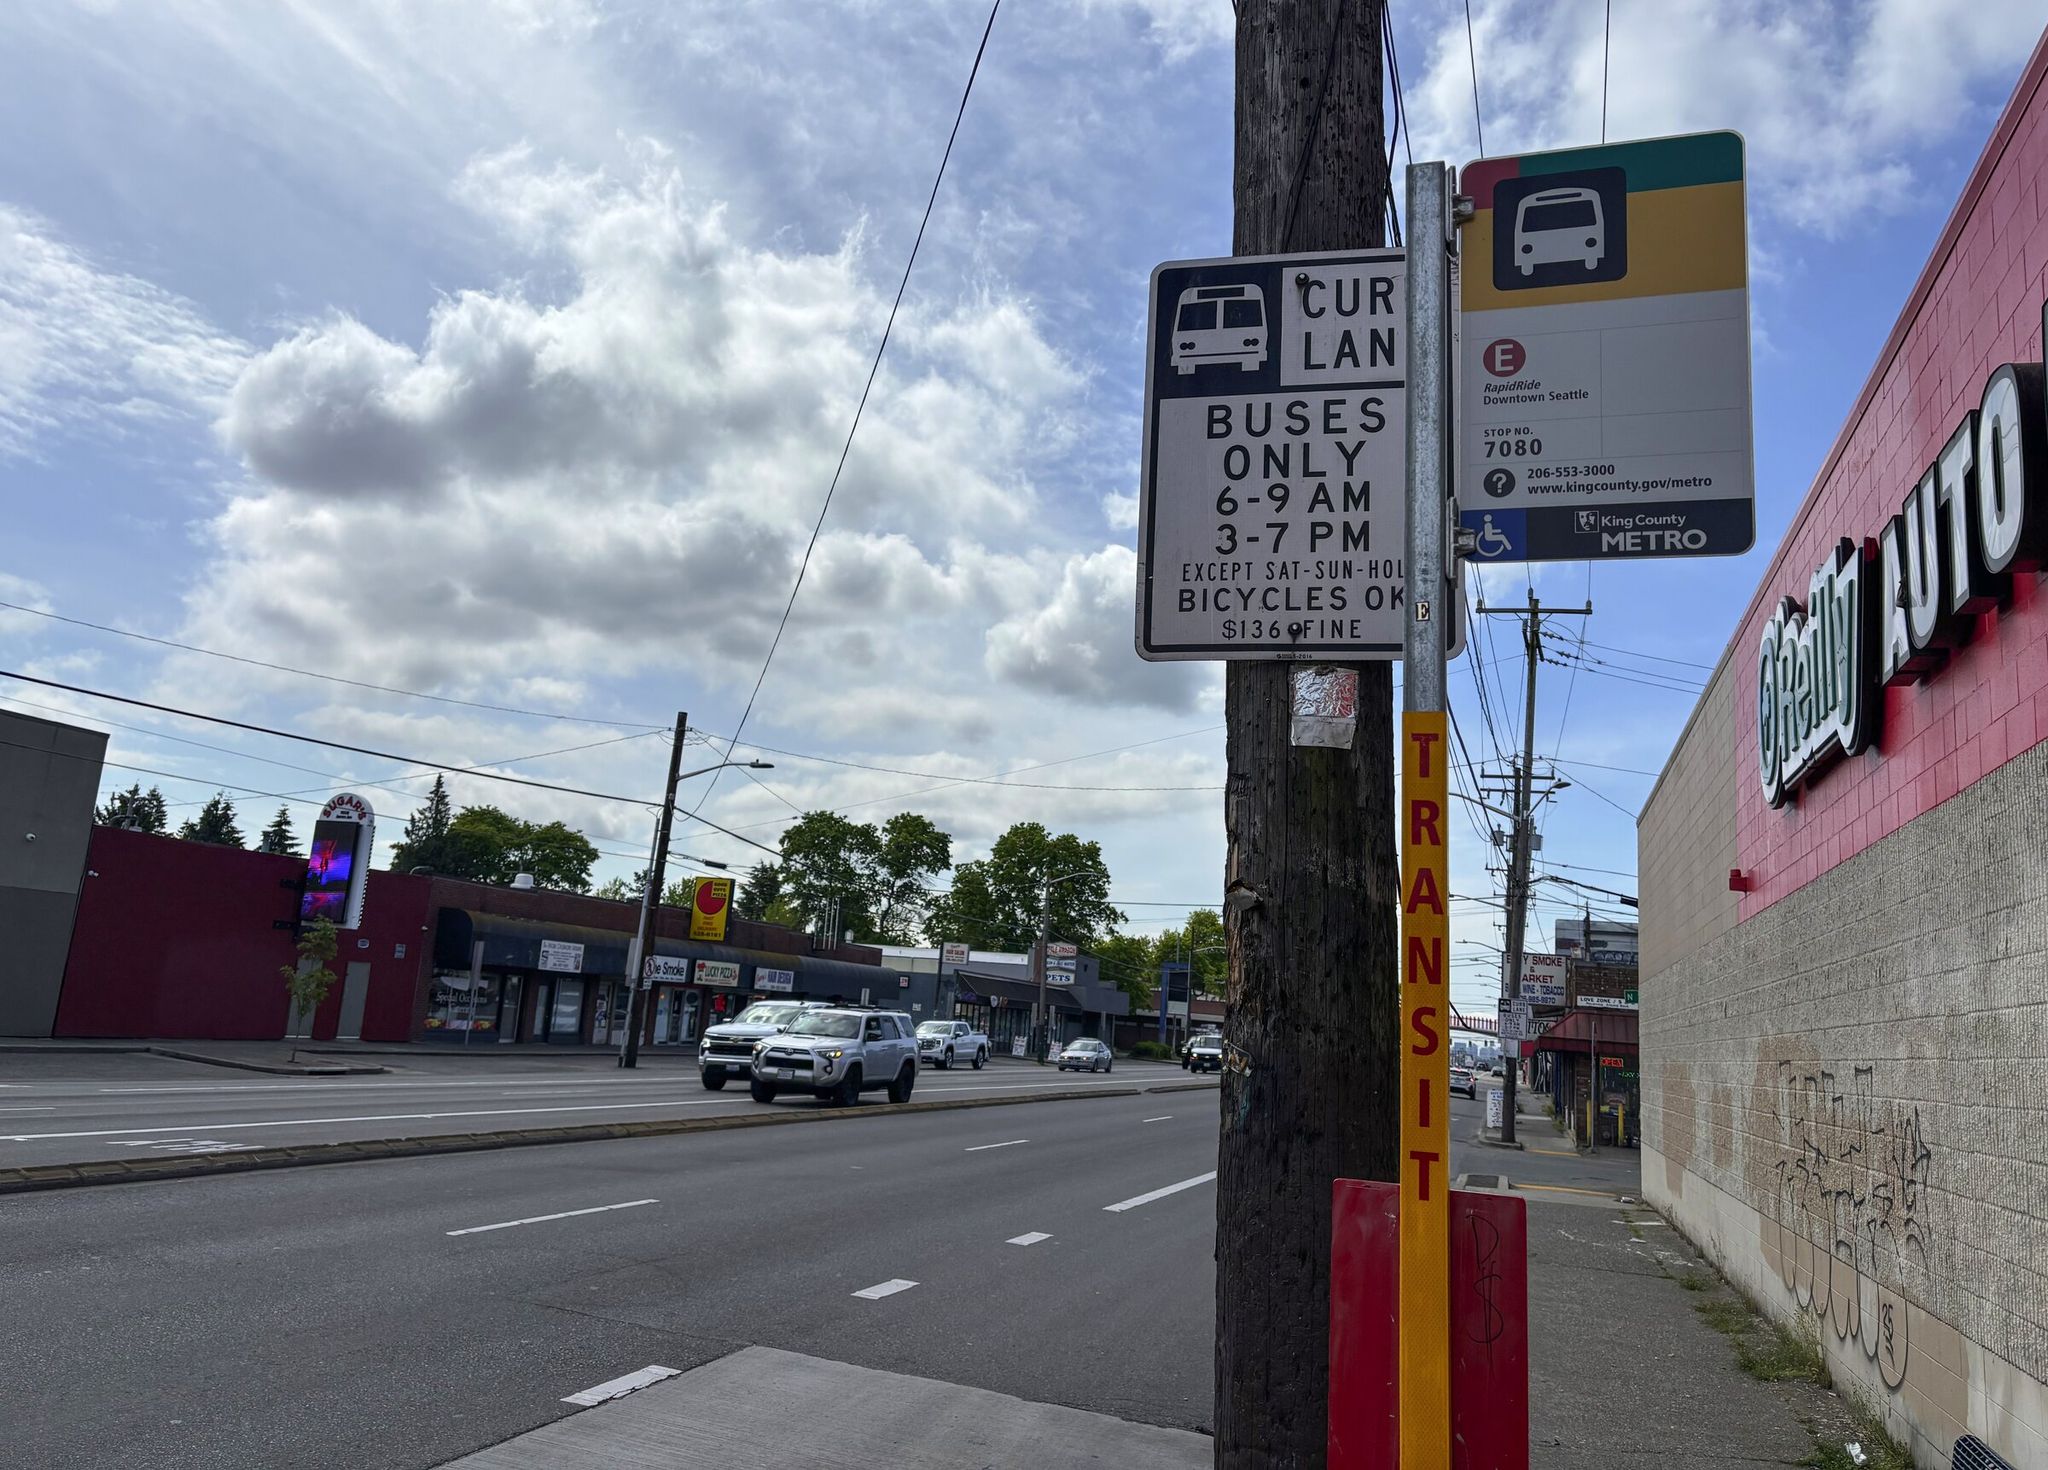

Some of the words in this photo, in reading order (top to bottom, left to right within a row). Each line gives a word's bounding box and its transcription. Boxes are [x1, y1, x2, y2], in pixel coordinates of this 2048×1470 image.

[1302, 277, 1395, 318] CUR
[1304, 328, 1395, 370] LAN
[1494, 344, 1515, 372] E
[1483, 379, 1541, 394] RapidRide
[1483, 392, 1545, 405] Downtown
[1548, 389, 1589, 402] Seattle
[1207, 398, 1386, 440] BUSES
[1484, 428, 1511, 438] STOP
[1514, 427, 1533, 436] NO.
[1484, 438, 1543, 458] 7080
[1223, 440, 1367, 481] ONLY
[1527, 464, 1615, 479] 206-553-3000
[1527, 475, 1713, 495] www.kingcounty.gov/metro
[1215, 482, 1291, 517] 6-9
[1307, 480, 1371, 513] AM
[1601, 514, 1633, 529] King
[1635, 513, 1686, 528] County
[1879, 363, 2025, 687] AUTO
[1215, 522, 1289, 555] 3-7
[1310, 520, 1370, 553] PM
[1601, 528, 1708, 553] METRO
[1182, 562, 1253, 582] EXCEPT
[1178, 585, 1347, 613] BICYCLES
[1364, 584, 1405, 611] OK
[1416, 602, 1429, 620] E
[1221, 618, 1281, 641] $136
[1303, 619, 1362, 640] FINE
[323, 796, 367, 821] SUGAR'S
[662, 960, 685, 976] Smoke
[1406, 732, 1443, 1201] TRANSIT
[1532, 955, 1563, 967] SMOKE
[1045, 973, 1071, 982] PETS
[1521, 974, 1555, 984] ARKET
[1539, 985, 1565, 996] TOBACCO
[1602, 1057, 1624, 1068] OPEN
